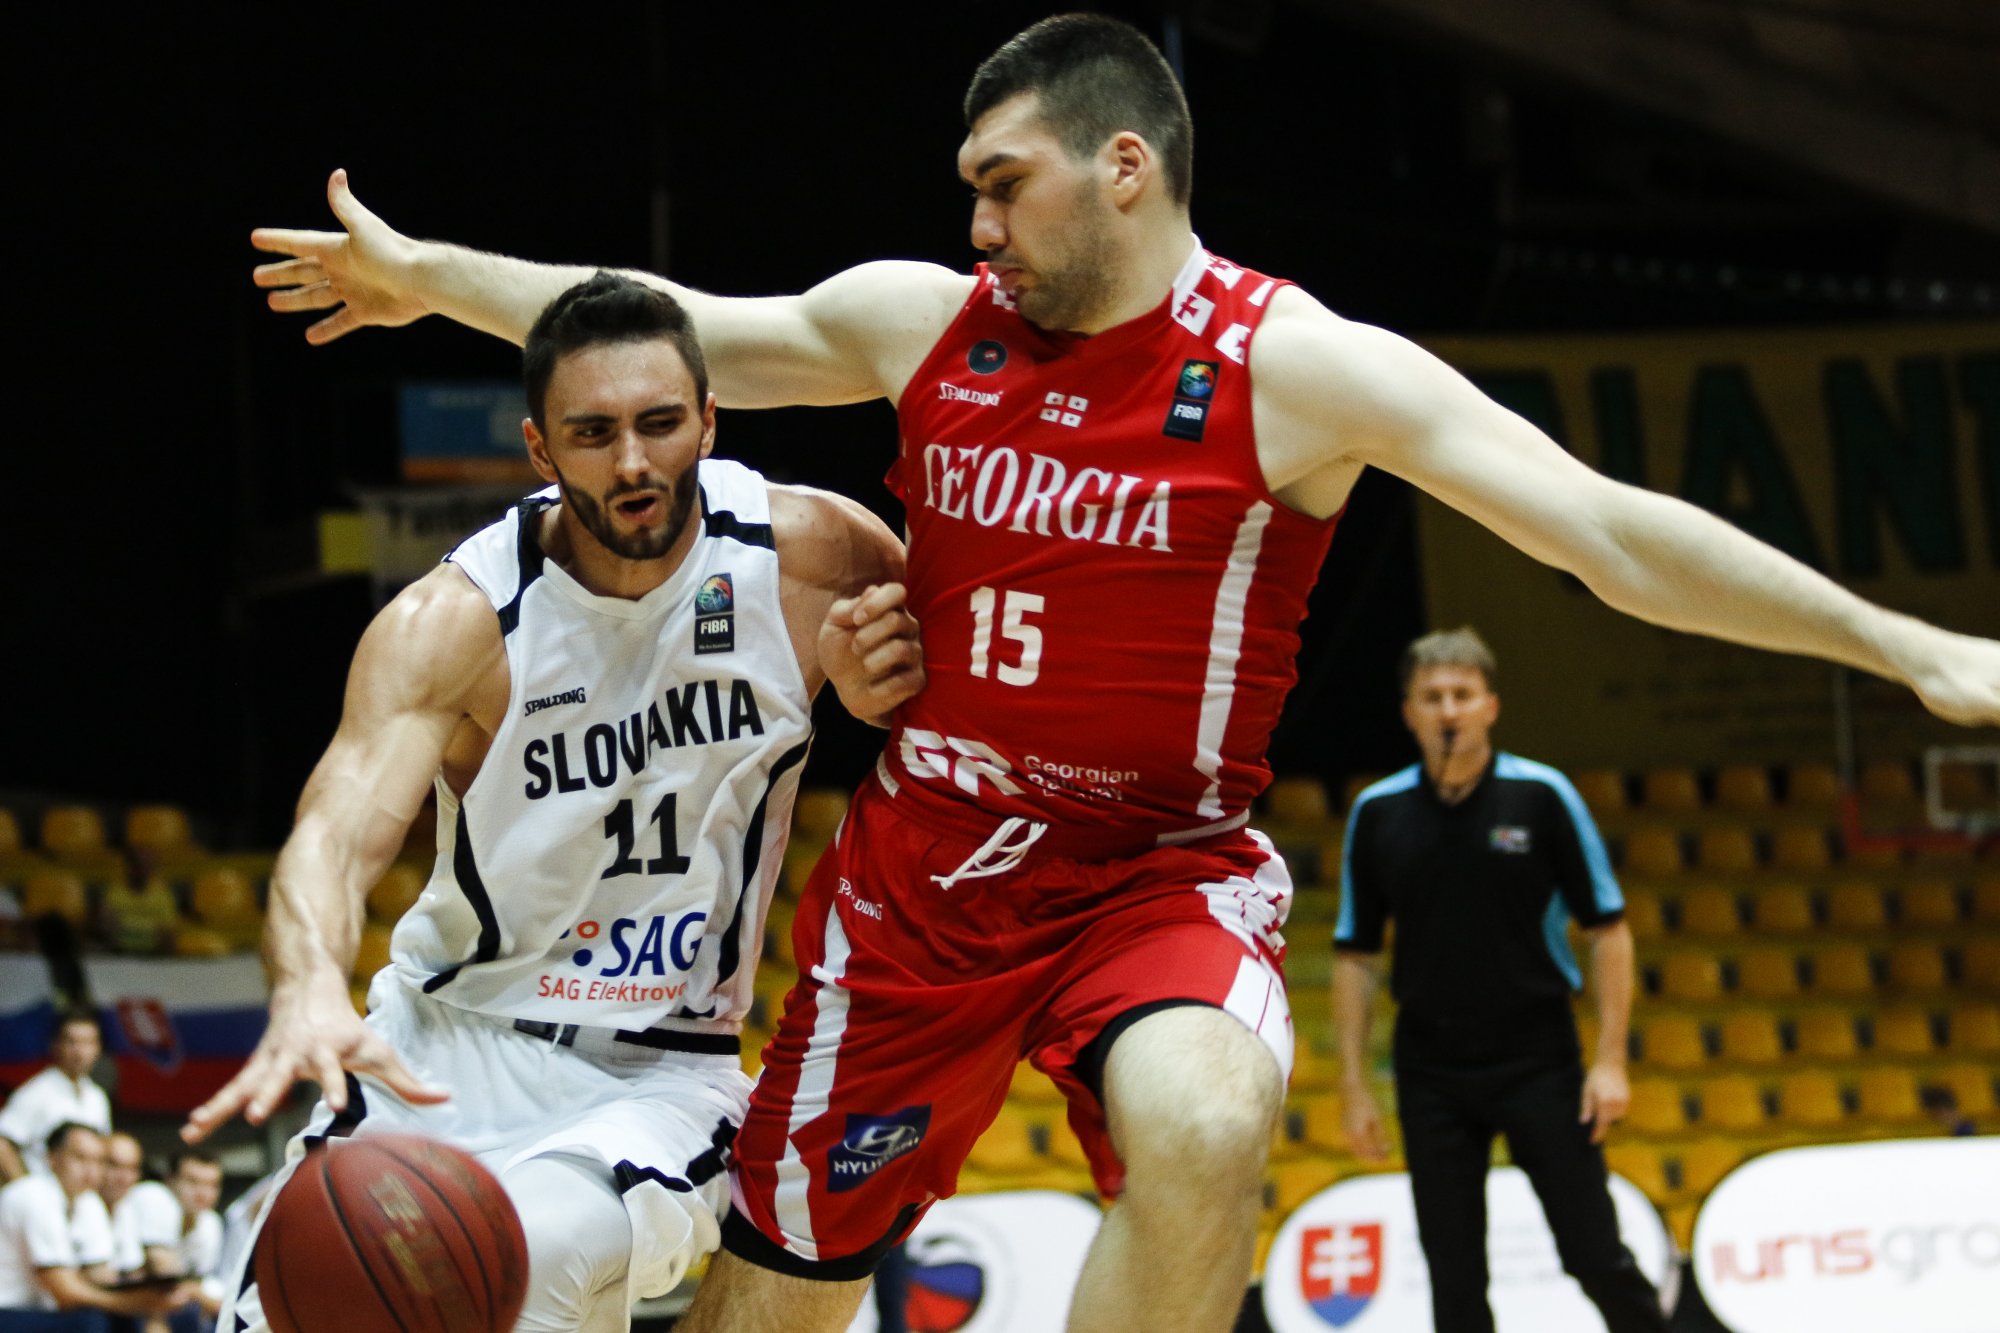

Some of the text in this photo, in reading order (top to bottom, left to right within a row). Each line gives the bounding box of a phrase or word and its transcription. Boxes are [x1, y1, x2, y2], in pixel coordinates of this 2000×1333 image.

[1173, 403, 1203, 421] FIBA
[700, 618, 729, 635] FIBA
[969, 586, 1045, 687] 15
[524, 687, 587, 717] SPALDING
[523, 678, 765, 800] SLOVAKIA
[1024, 755, 1139, 783] Georgian
[600, 791, 691, 880] 11
[600, 911, 707, 978] SAG
[537, 975, 580, 1001] SAG
